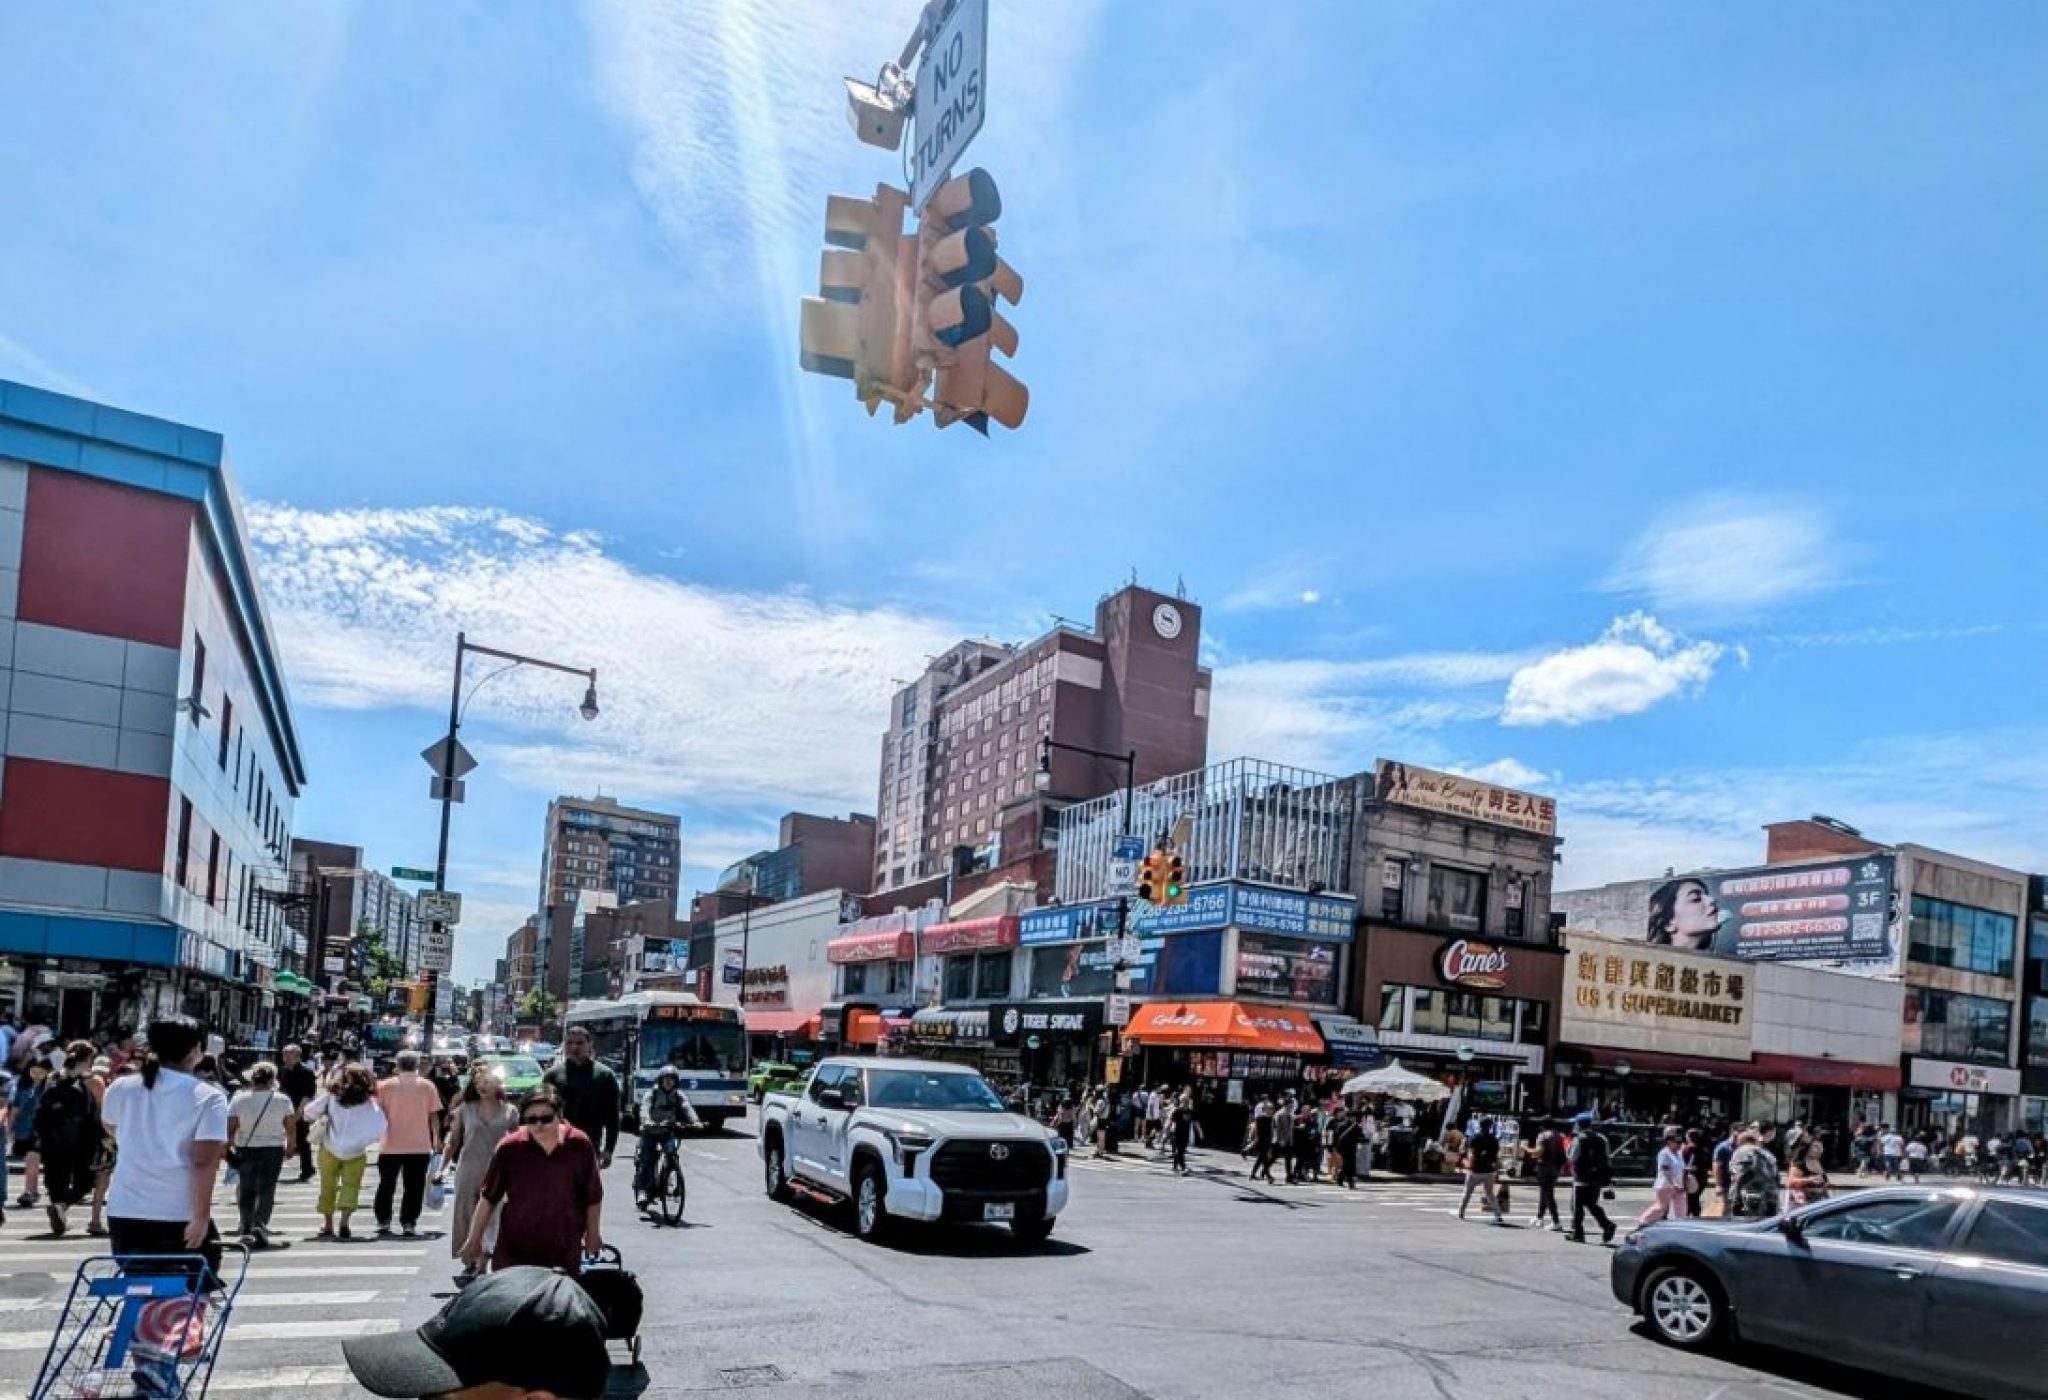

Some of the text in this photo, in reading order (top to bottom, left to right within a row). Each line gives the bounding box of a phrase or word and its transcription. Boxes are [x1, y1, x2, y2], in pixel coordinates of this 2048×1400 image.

[932, 32, 963, 105] NO
[917, 68, 978, 181] TURNS
[1115, 866, 1130, 877] NO
[1856, 891, 1881, 908] 3F
[1443, 939, 1508, 981] Cane's
[1576, 984, 1743, 1025] US 1 SUPERMARKET
